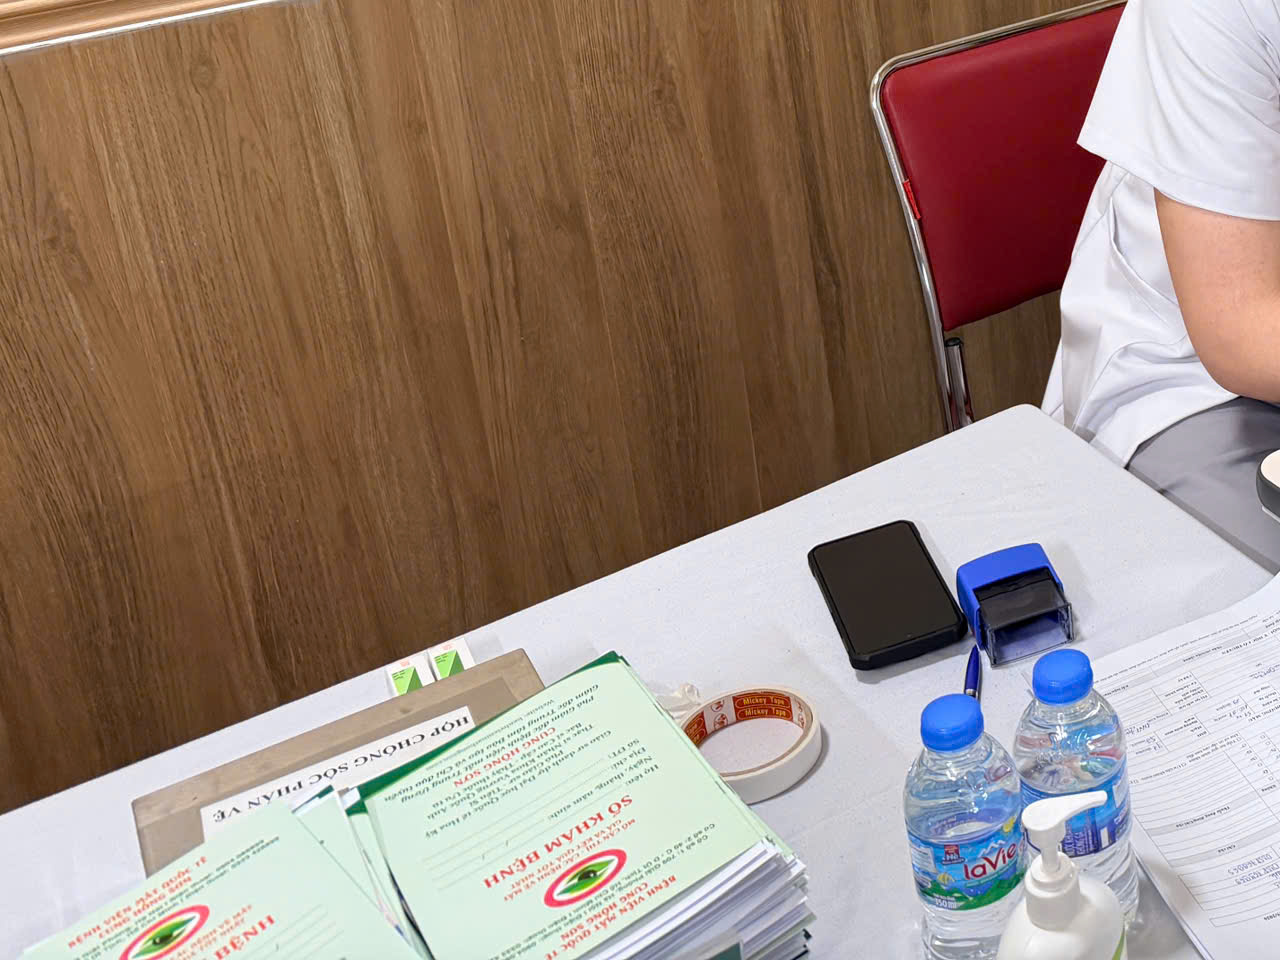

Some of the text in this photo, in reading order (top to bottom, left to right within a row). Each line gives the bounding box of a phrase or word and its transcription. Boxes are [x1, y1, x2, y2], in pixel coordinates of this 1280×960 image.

[430, 716, 468, 736] HỘP
[354, 734, 424, 766] CHỐNG
[384, 684, 598, 801] Giám đốc Trung tâm Đào tạo và Chỉ đạo tuyến
[400, 695, 593, 802] Phó Giám đốc Bệnh viện mắt Trung Ương
[453, 727, 555, 787] CUNG HỒNG SƠN
[309, 762, 348, 784] SỐC
[425, 730, 611, 837] Giáo sư danh dự Đại học Quốc tế Hoa Kỳ
[213, 807, 240, 822] VỆ
[544, 812, 603, 852] KHÁM
[484, 850, 539, 887] BỆNH
[646, 875, 675, 896] BỆNH
[560, 882, 647, 940] CUNG HỒNG SƠN
[618, 895, 644, 914] VIỆN
[594, 912, 616, 930] MẮT
[560, 929, 590, 950] QUỐC
